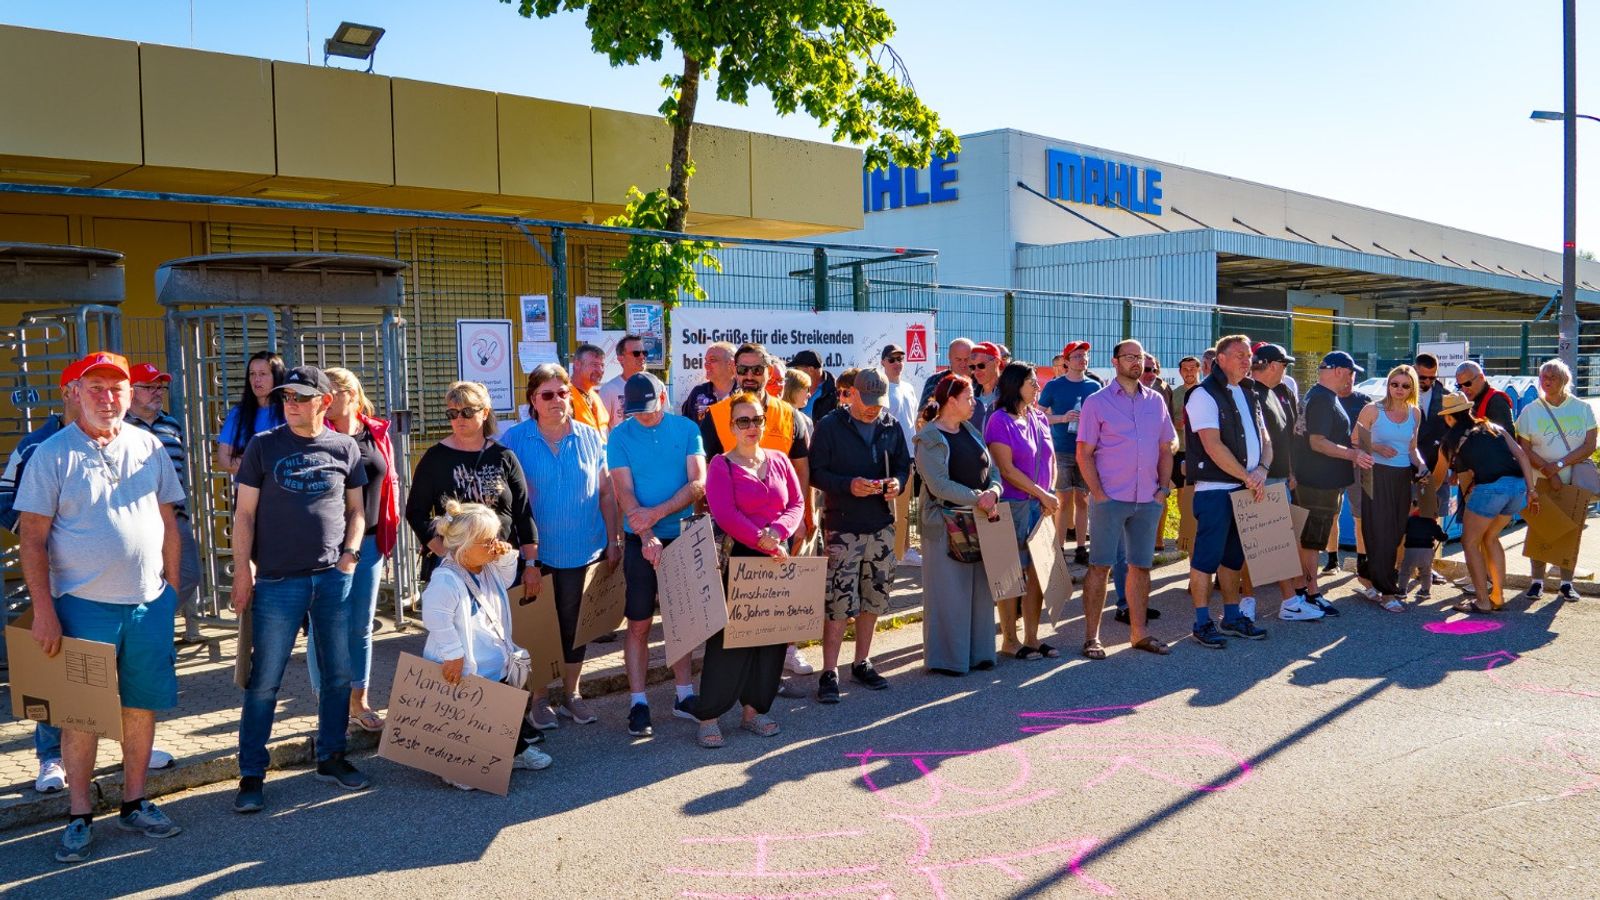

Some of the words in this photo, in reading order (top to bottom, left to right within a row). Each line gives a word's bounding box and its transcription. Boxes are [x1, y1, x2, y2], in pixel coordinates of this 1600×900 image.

[864, 150, 959, 213] HLE
[1045, 149, 1163, 216] MAHLE
[682, 328, 749, 344] Soli-Grüße
[751, 329, 768, 344] für
[771, 329, 788, 344] die
[791, 329, 854, 344] Streikenden
[682, 353, 703, 370] bei
[690, 526, 707, 580] Hans
[731, 586, 790, 601] Umschülerin
[729, 604, 742, 621] 16
[743, 604, 770, 622] Jahre
[773, 605, 785, 617] im
[786, 604, 815, 617] Betrieb
[398, 693, 425, 709] seit
[432, 699, 466, 721] 1990
[393, 713, 421, 727] und
[423, 721, 449, 735] auf
[447, 729, 471, 745] das
[390, 727, 421, 751] Beste
[424, 745, 477, 767] reduziert
